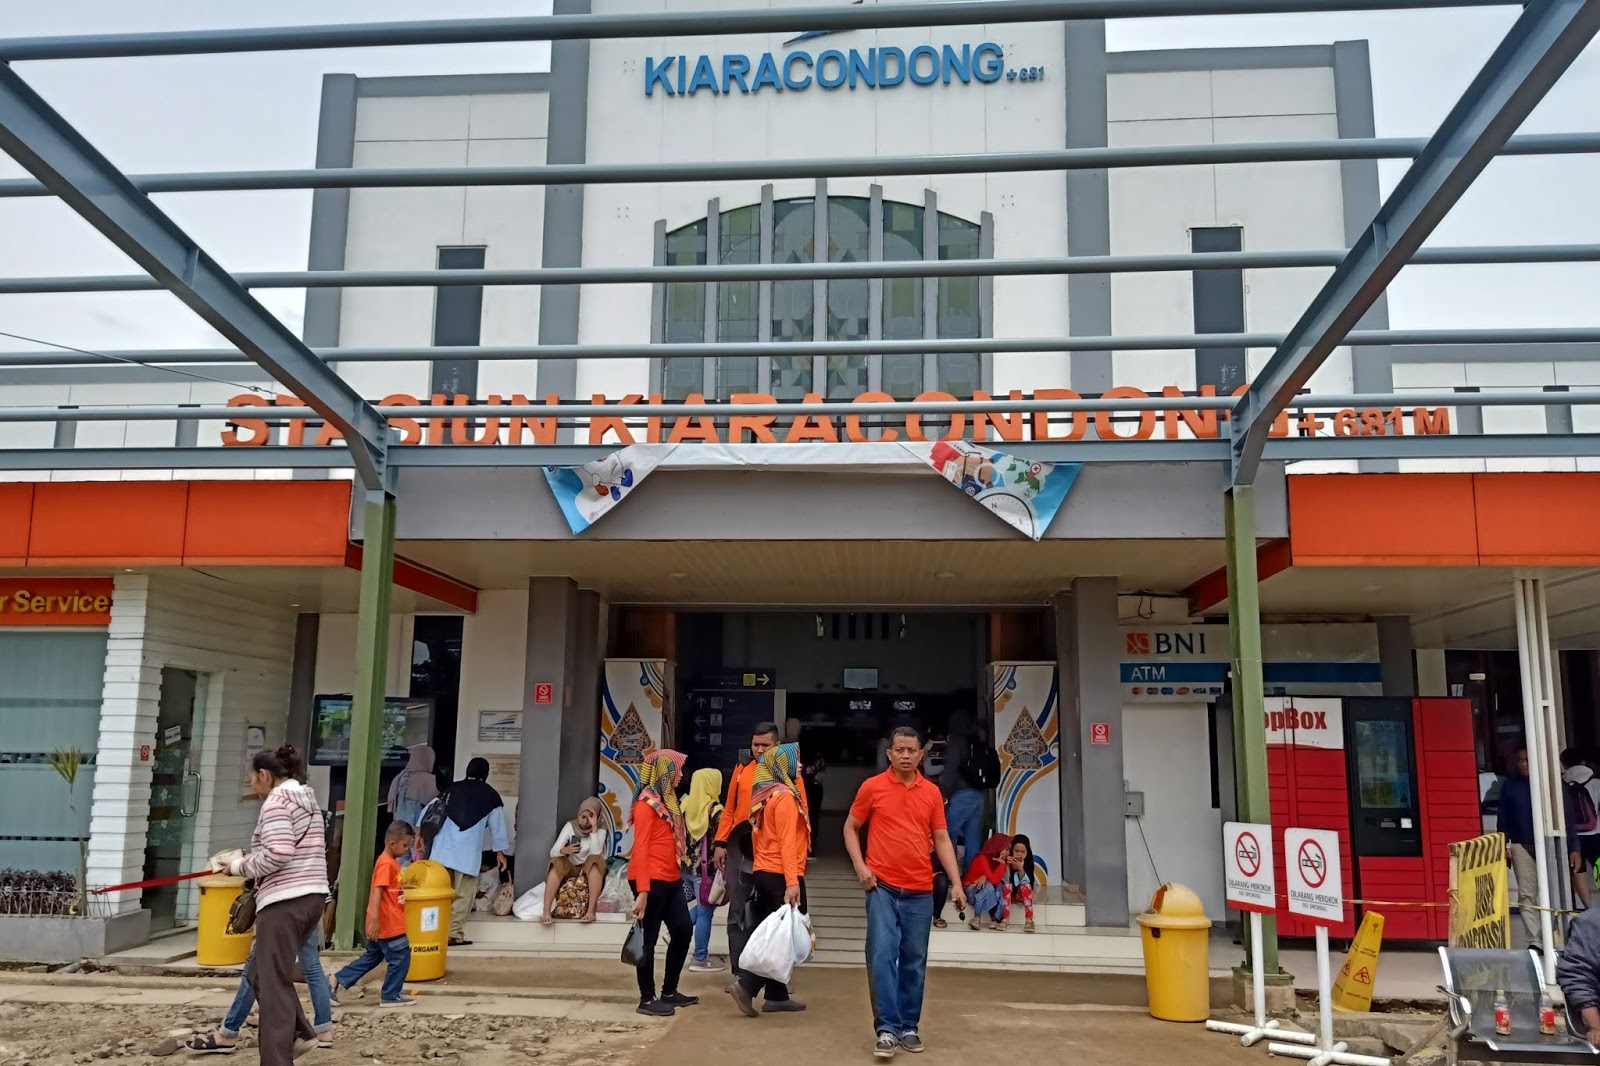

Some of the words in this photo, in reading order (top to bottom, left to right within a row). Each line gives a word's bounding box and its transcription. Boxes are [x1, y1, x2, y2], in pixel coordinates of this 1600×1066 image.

[645, 43, 1004, 96] KIARACONDONG
[1413, 407, 1450, 435] M
[14, 590, 109, 612] Service
[1155, 633, 1206, 654] BNI
[1131, 666, 1166, 680] ATM
[1228, 879, 1250, 888] DILARANG
[1250, 881, 1271, 892] MEROKOK
[1290, 890, 1314, 900] DILARANG
[1315, 893, 1339, 904] MEROKOK
[413, 945, 439, 953] ORGANIK
